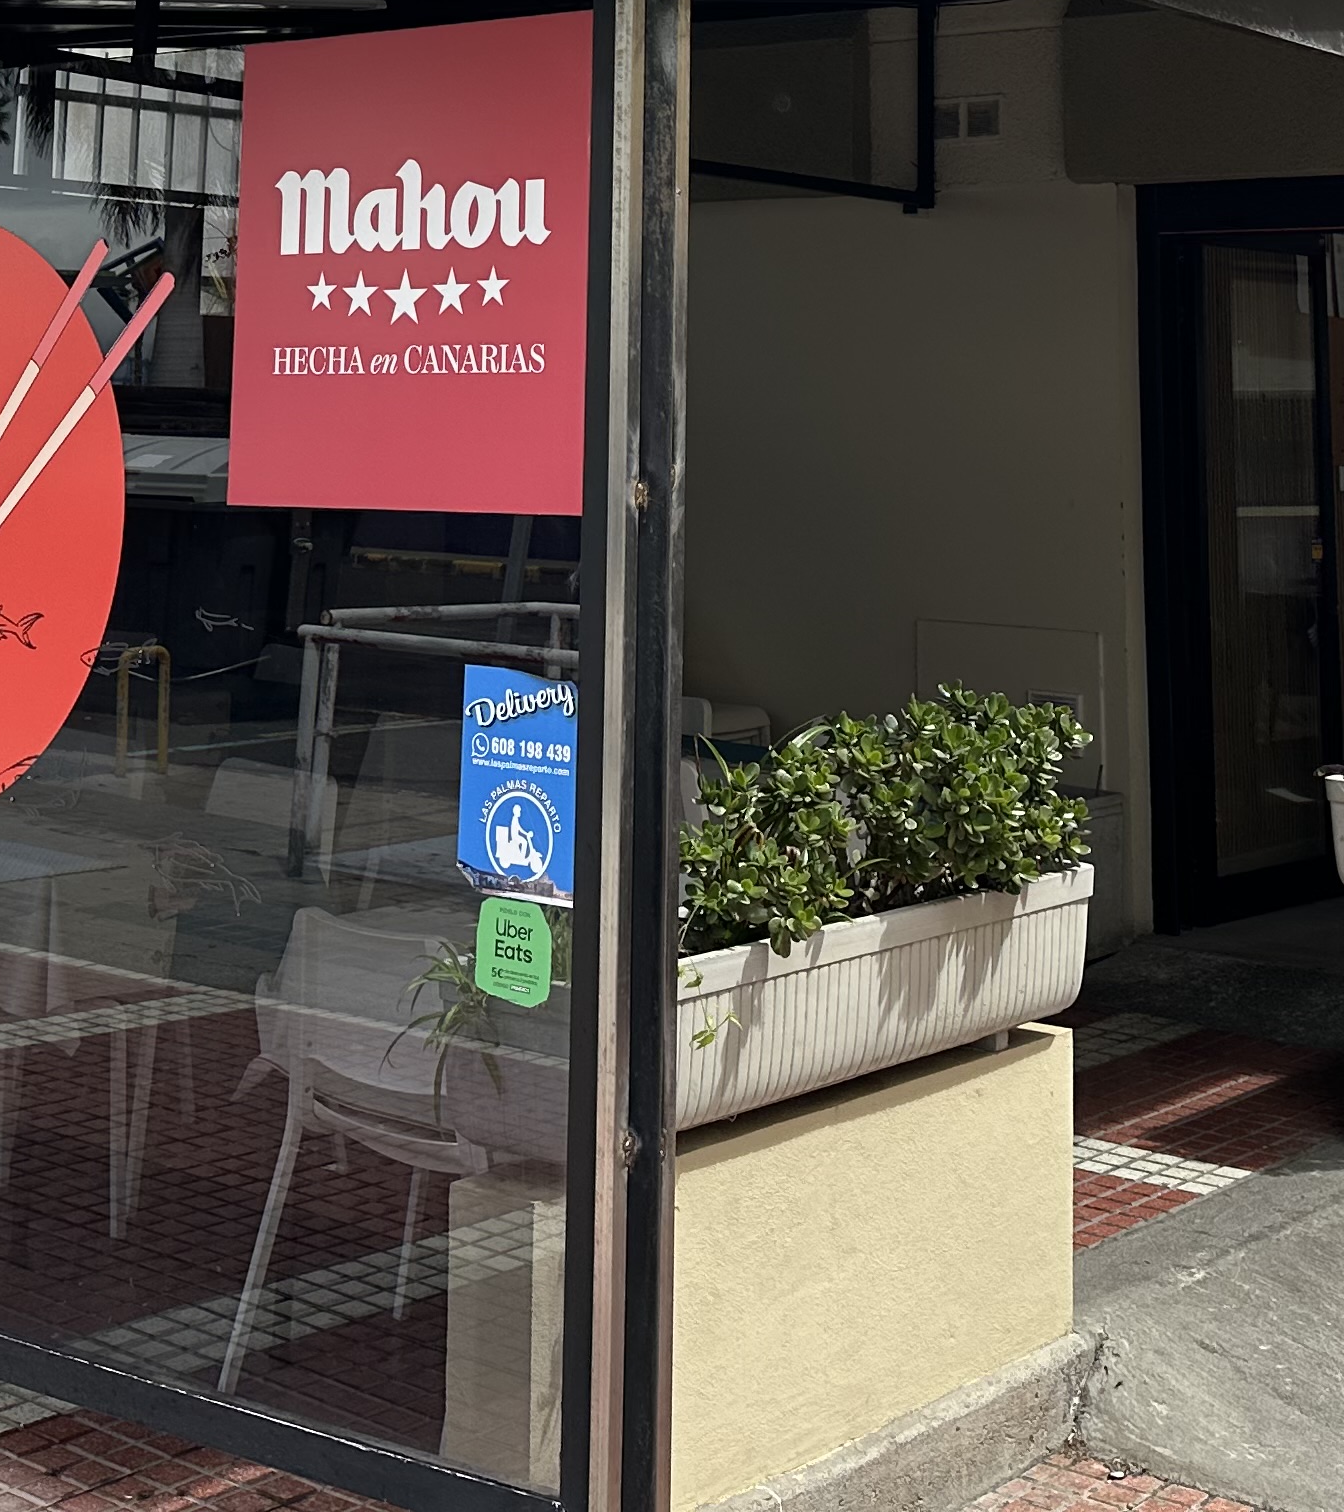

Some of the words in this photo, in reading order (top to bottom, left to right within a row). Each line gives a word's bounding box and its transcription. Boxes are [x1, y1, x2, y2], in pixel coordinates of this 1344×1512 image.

[274, 158, 552, 256] Mahou
[272, 345, 366, 376] HECHA
[370, 352, 398, 374] en
[403, 343, 546, 375] CANARIAS
[465, 683, 575, 727] Delivery
[491, 736, 515, 756] 608
[519, 739, 543, 759] 198
[546, 743, 571, 763] 439
[478, 800, 493, 823] LAS
[490, 779, 527, 801] PALMAS
[529, 782, 562, 833] REPARTO
[495, 917, 534, 941] Uber
[494, 939, 533, 964] Eats
